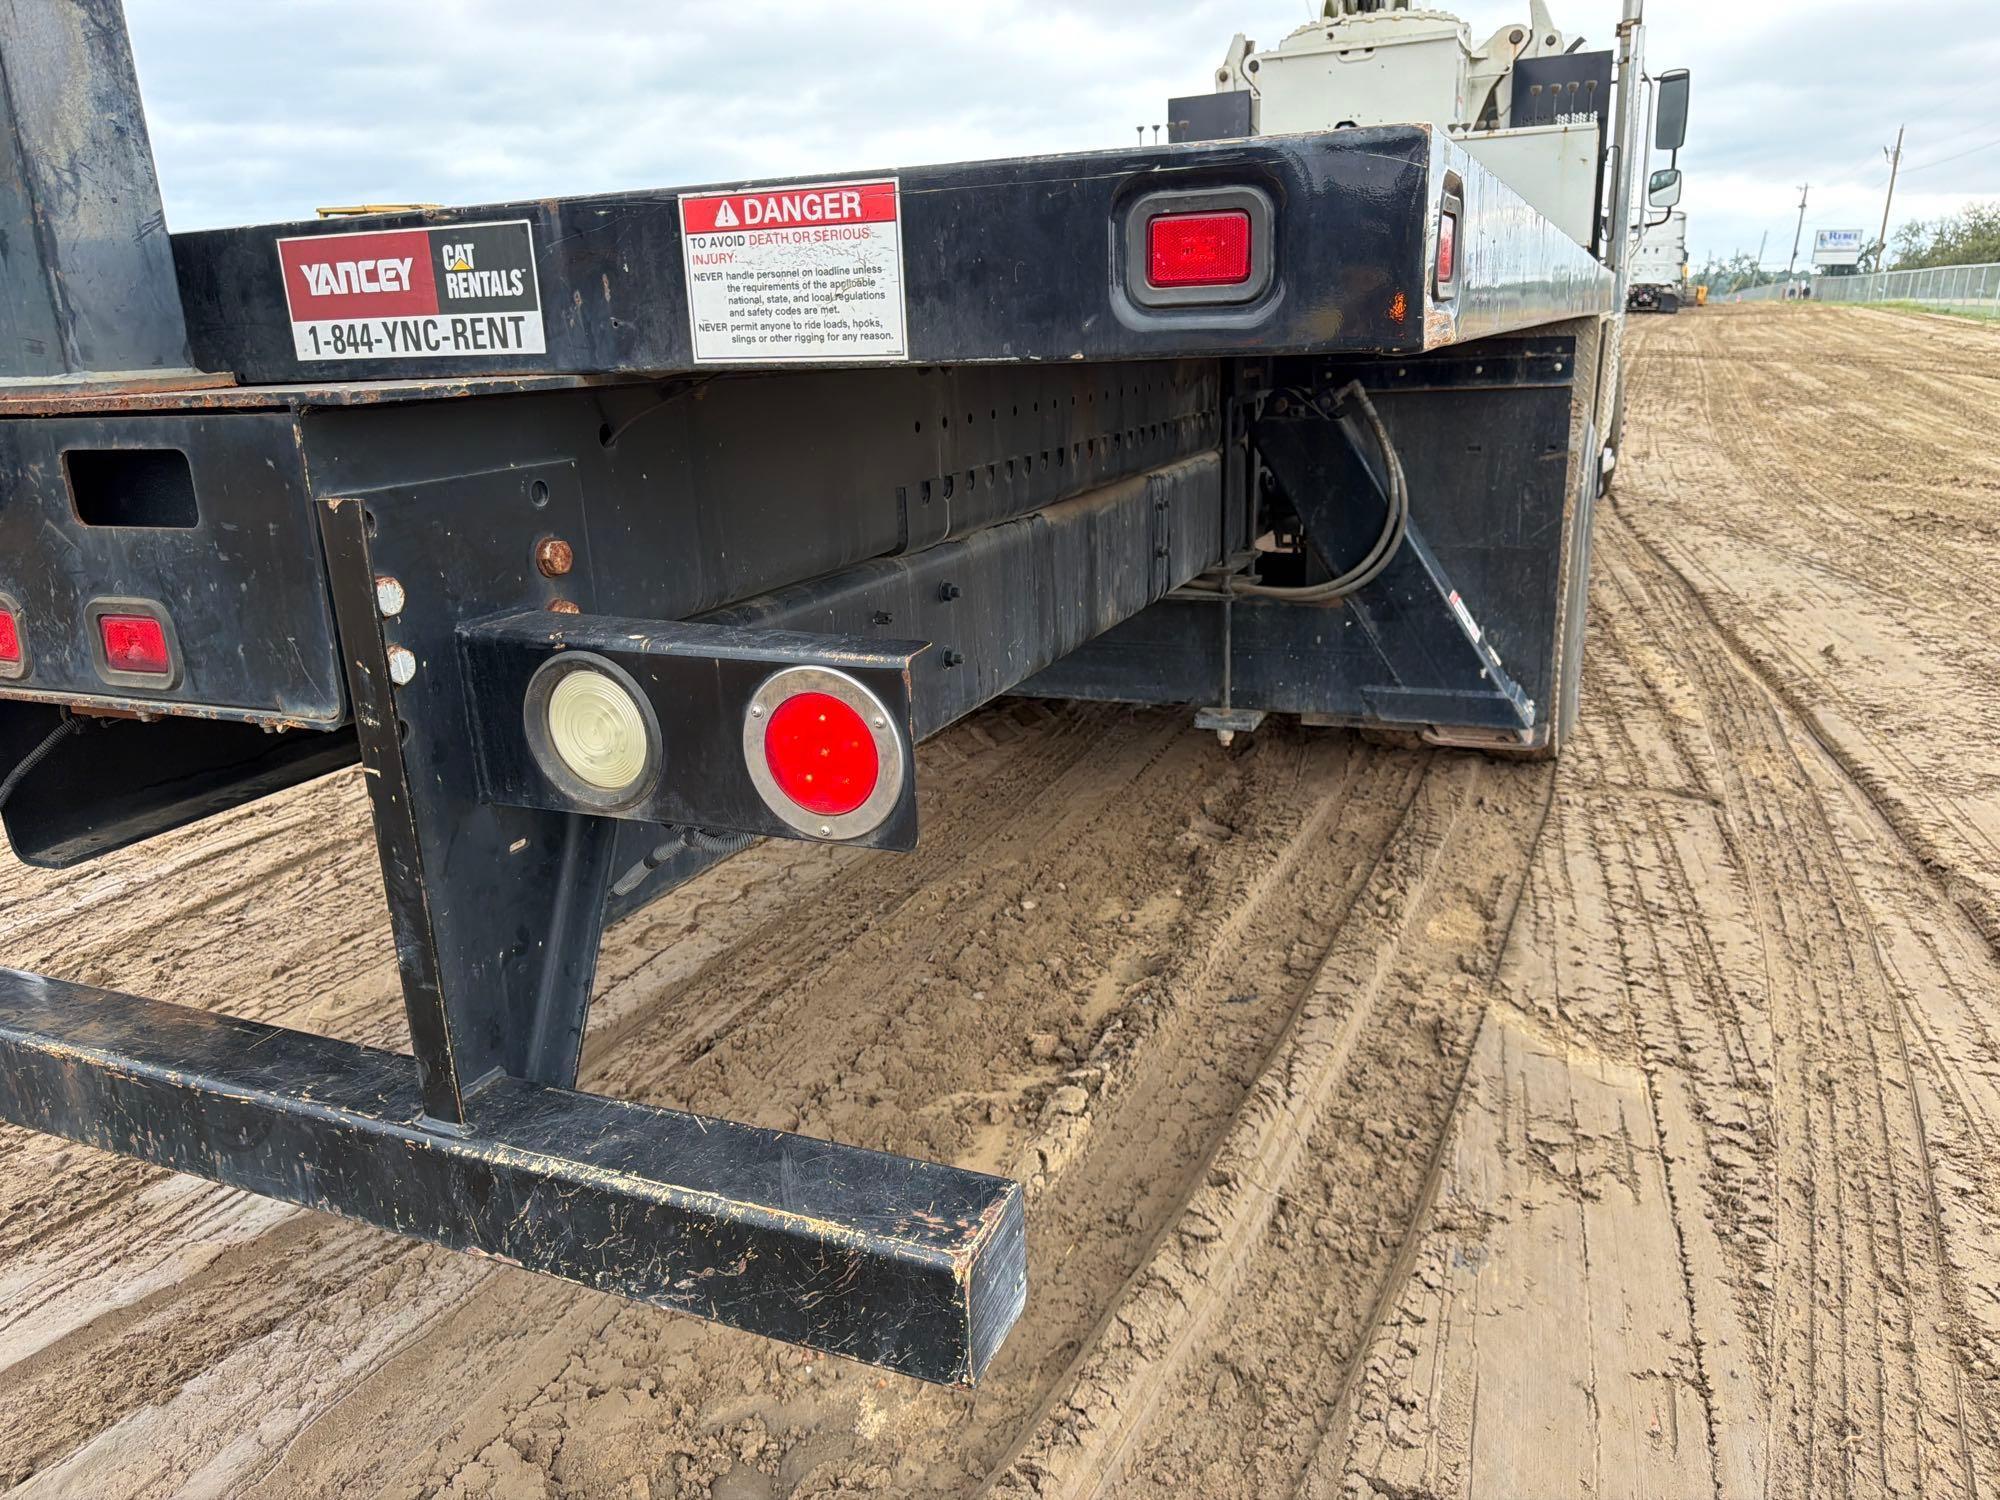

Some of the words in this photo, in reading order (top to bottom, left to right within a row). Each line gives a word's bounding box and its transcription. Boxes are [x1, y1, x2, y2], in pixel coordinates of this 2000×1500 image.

[744, 192, 861, 225] DANGER
[690, 238, 706, 249] TO
[710, 236, 745, 248] AVOID
[749, 232, 789, 245] DEATH
[792, 231, 810, 243] OR
[813, 227, 870, 242] SERIOUS
[442, 243, 475, 271] CAT
[693, 253, 738, 265] INJURY:
[300, 257, 414, 296] YANCEY
[694, 273, 723, 281] NEVER
[726, 271, 754, 280] handle
[757, 268, 800, 279] personnel
[816, 266, 850, 276] loadline
[853, 266, 882, 274] unless
[447, 269, 524, 299] RENTALS
[727, 284, 740, 292] the
[743, 280, 799, 292] requirements
[802, 279, 811, 289] of
[813, 279, 827, 288] the
[728, 295, 764, 305] national,
[766, 295, 790, 304] state,
[793, 294, 809, 302] and
[812, 293, 833, 302] local
[835, 291, 885, 302] regulations
[730, 308, 745, 317] and
[748, 308, 772, 318] safety
[775, 307, 801, 316] codes
[820, 306, 840, 314] met.
[699, 323, 727, 332] NEVER
[731, 322, 758, 332] permit
[760, 321, 791, 331] anyone
[805, 321, 821, 329] ride
[824, 320, 850, 329] loads,
[853, 319, 883, 328] hooks,
[309, 316, 525, 355] 1-844-YNC-RENT
[732, 335, 756, 344] slings
[770, 333, 792, 343] other
[795, 332, 825, 343] rigging
[827, 331, 839, 340] for
[842, 332, 858, 342] any
[860, 331, 894, 340] reason.
